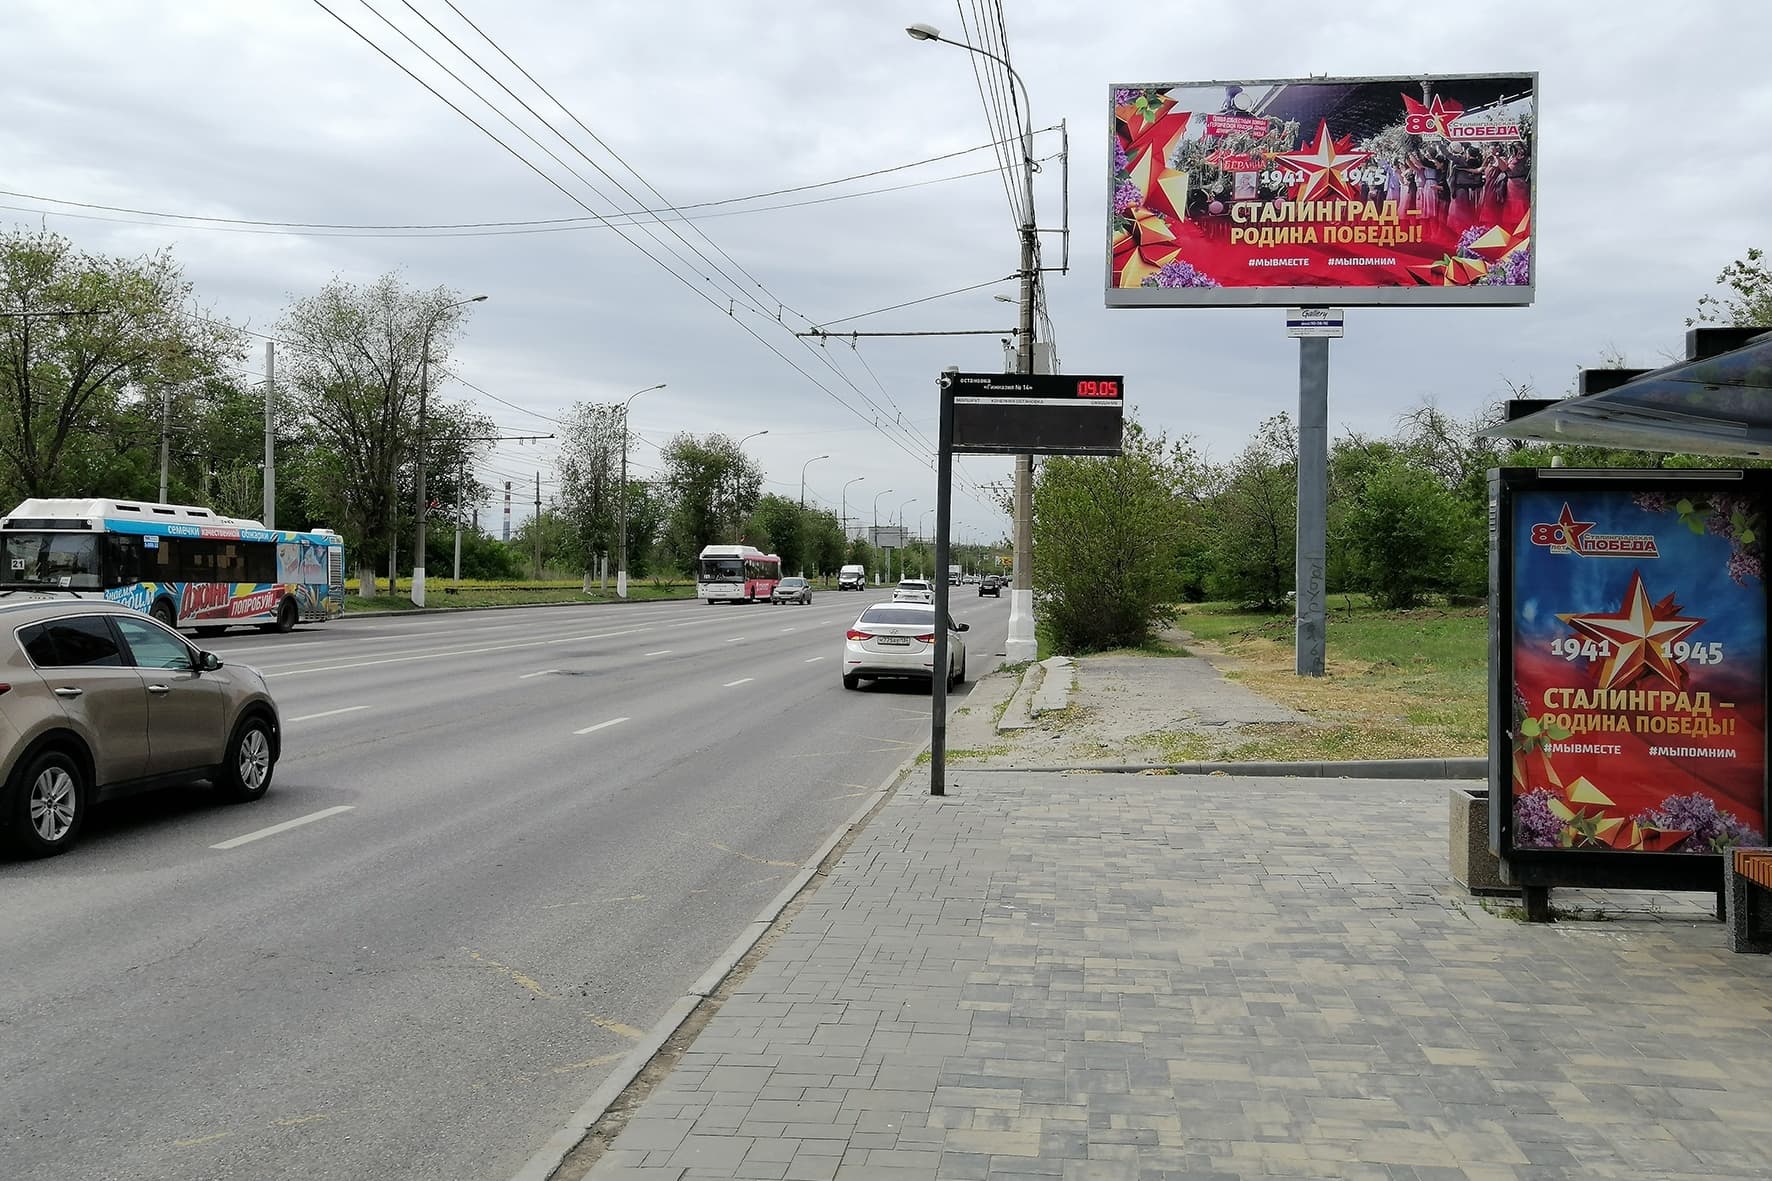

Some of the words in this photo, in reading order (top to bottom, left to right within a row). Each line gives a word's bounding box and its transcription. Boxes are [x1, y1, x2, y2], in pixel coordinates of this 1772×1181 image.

[1453, 125, 1519, 137] ПОБЕДА
[1261, 170, 1305, 187] 1941
[1340, 169, 1387, 187] 1945
[1231, 200, 1399, 226] СТАЛИНГРАД
[1230, 226, 1318, 248] РОДИНА
[1323, 225, 1423, 247] ПОБЕДЫ!
[1248, 258, 1310, 267] #МЫВМЕСТЕ
[1327, 257, 1396, 266] #МЫПОМНИМ
[1078, 381, 1118, 397] 09.05
[1584, 540, 1657, 552] ПОБЕДА
[12, 560, 24, 569] 21
[231, 592, 274, 617] ПОПРОБУЙ!
[1550, 638, 1611, 662] 1941
[1660, 641, 1724, 665] 1945
[1543, 687, 1712, 717] СТАЛИНГРАД
[1543, 712, 1631, 734] РОДИНА
[1635, 715, 1736, 738] ПОБЕДЫ!
[1543, 743, 1622, 755] #МЫВМЕСТЕ
[1648, 746, 1737, 759] #МЫПОМНИМ
